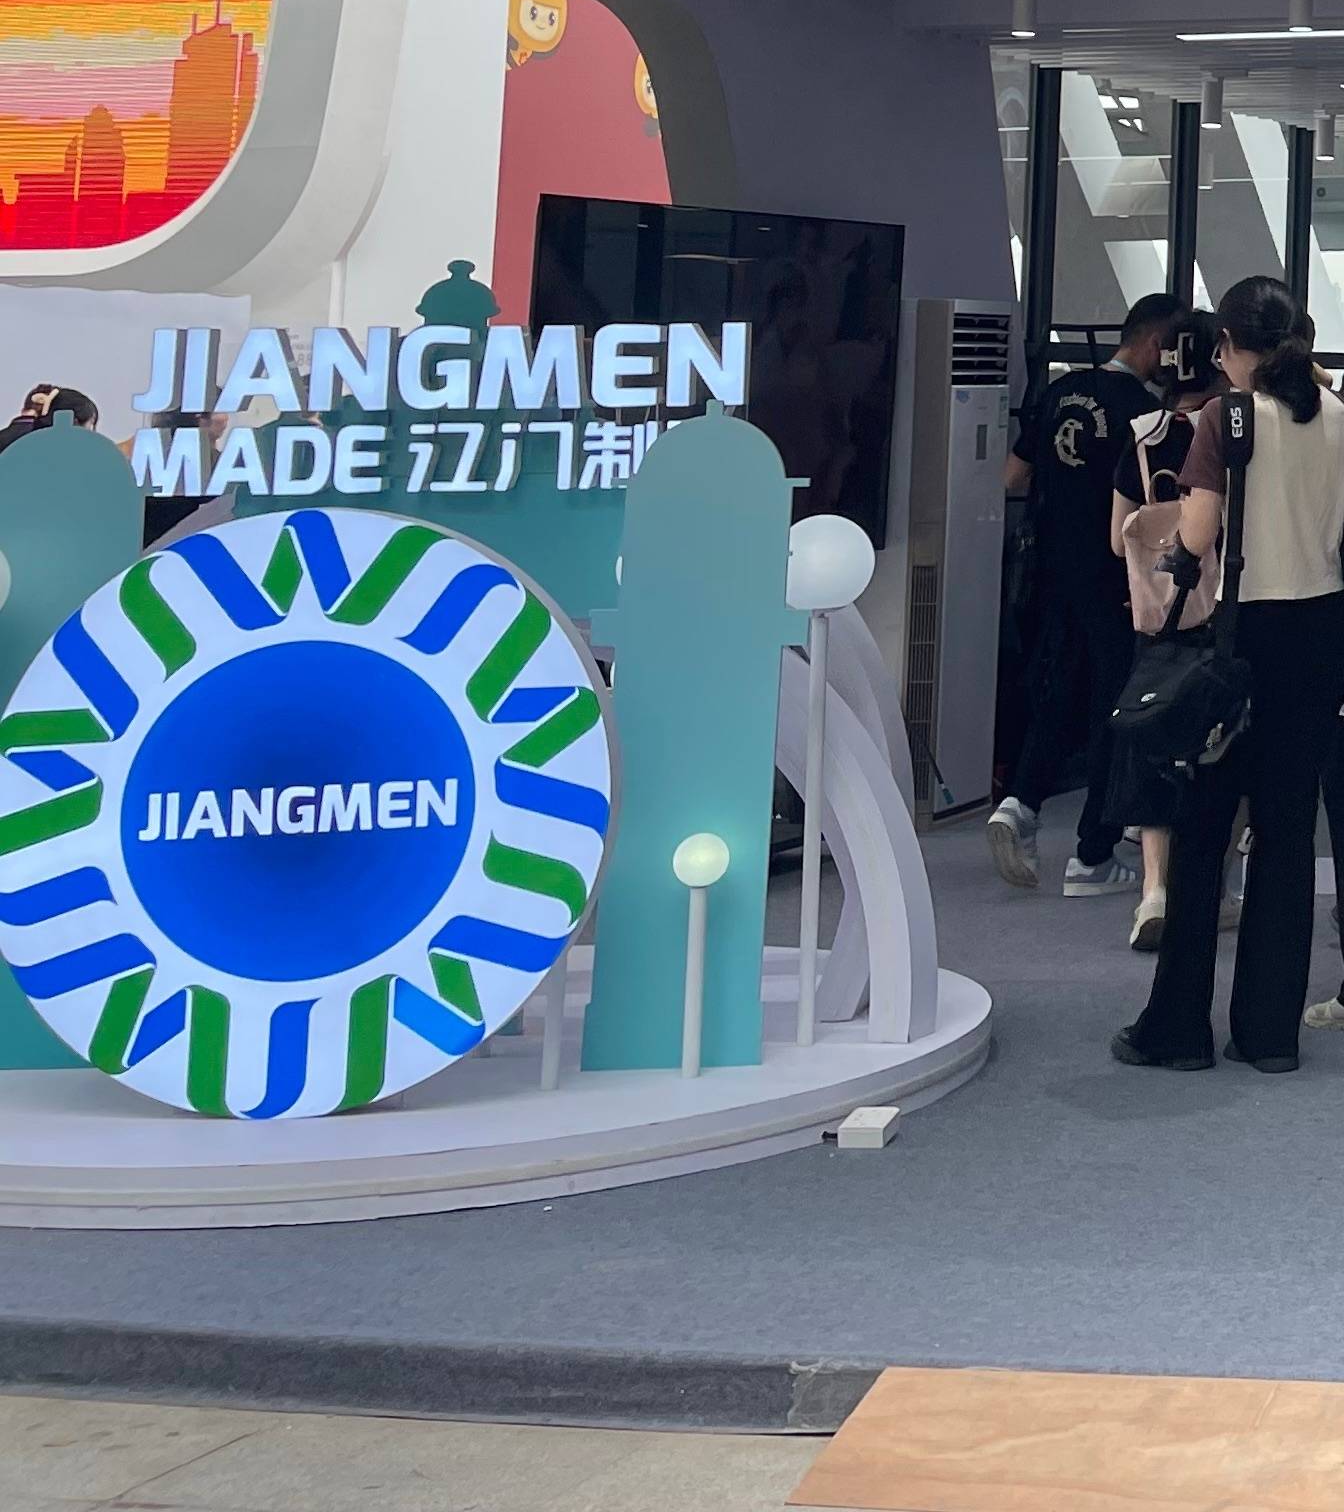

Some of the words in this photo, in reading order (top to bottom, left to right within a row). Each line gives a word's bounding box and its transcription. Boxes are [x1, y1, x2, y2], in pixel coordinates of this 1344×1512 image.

[132, 321, 749, 413] JIANGMEN
[1229, 406, 1244, 438] EOS
[132, 424, 387, 498] MADE
[406, 422, 683, 494] 江门制
[138, 778, 458, 841] JIANGMEN
